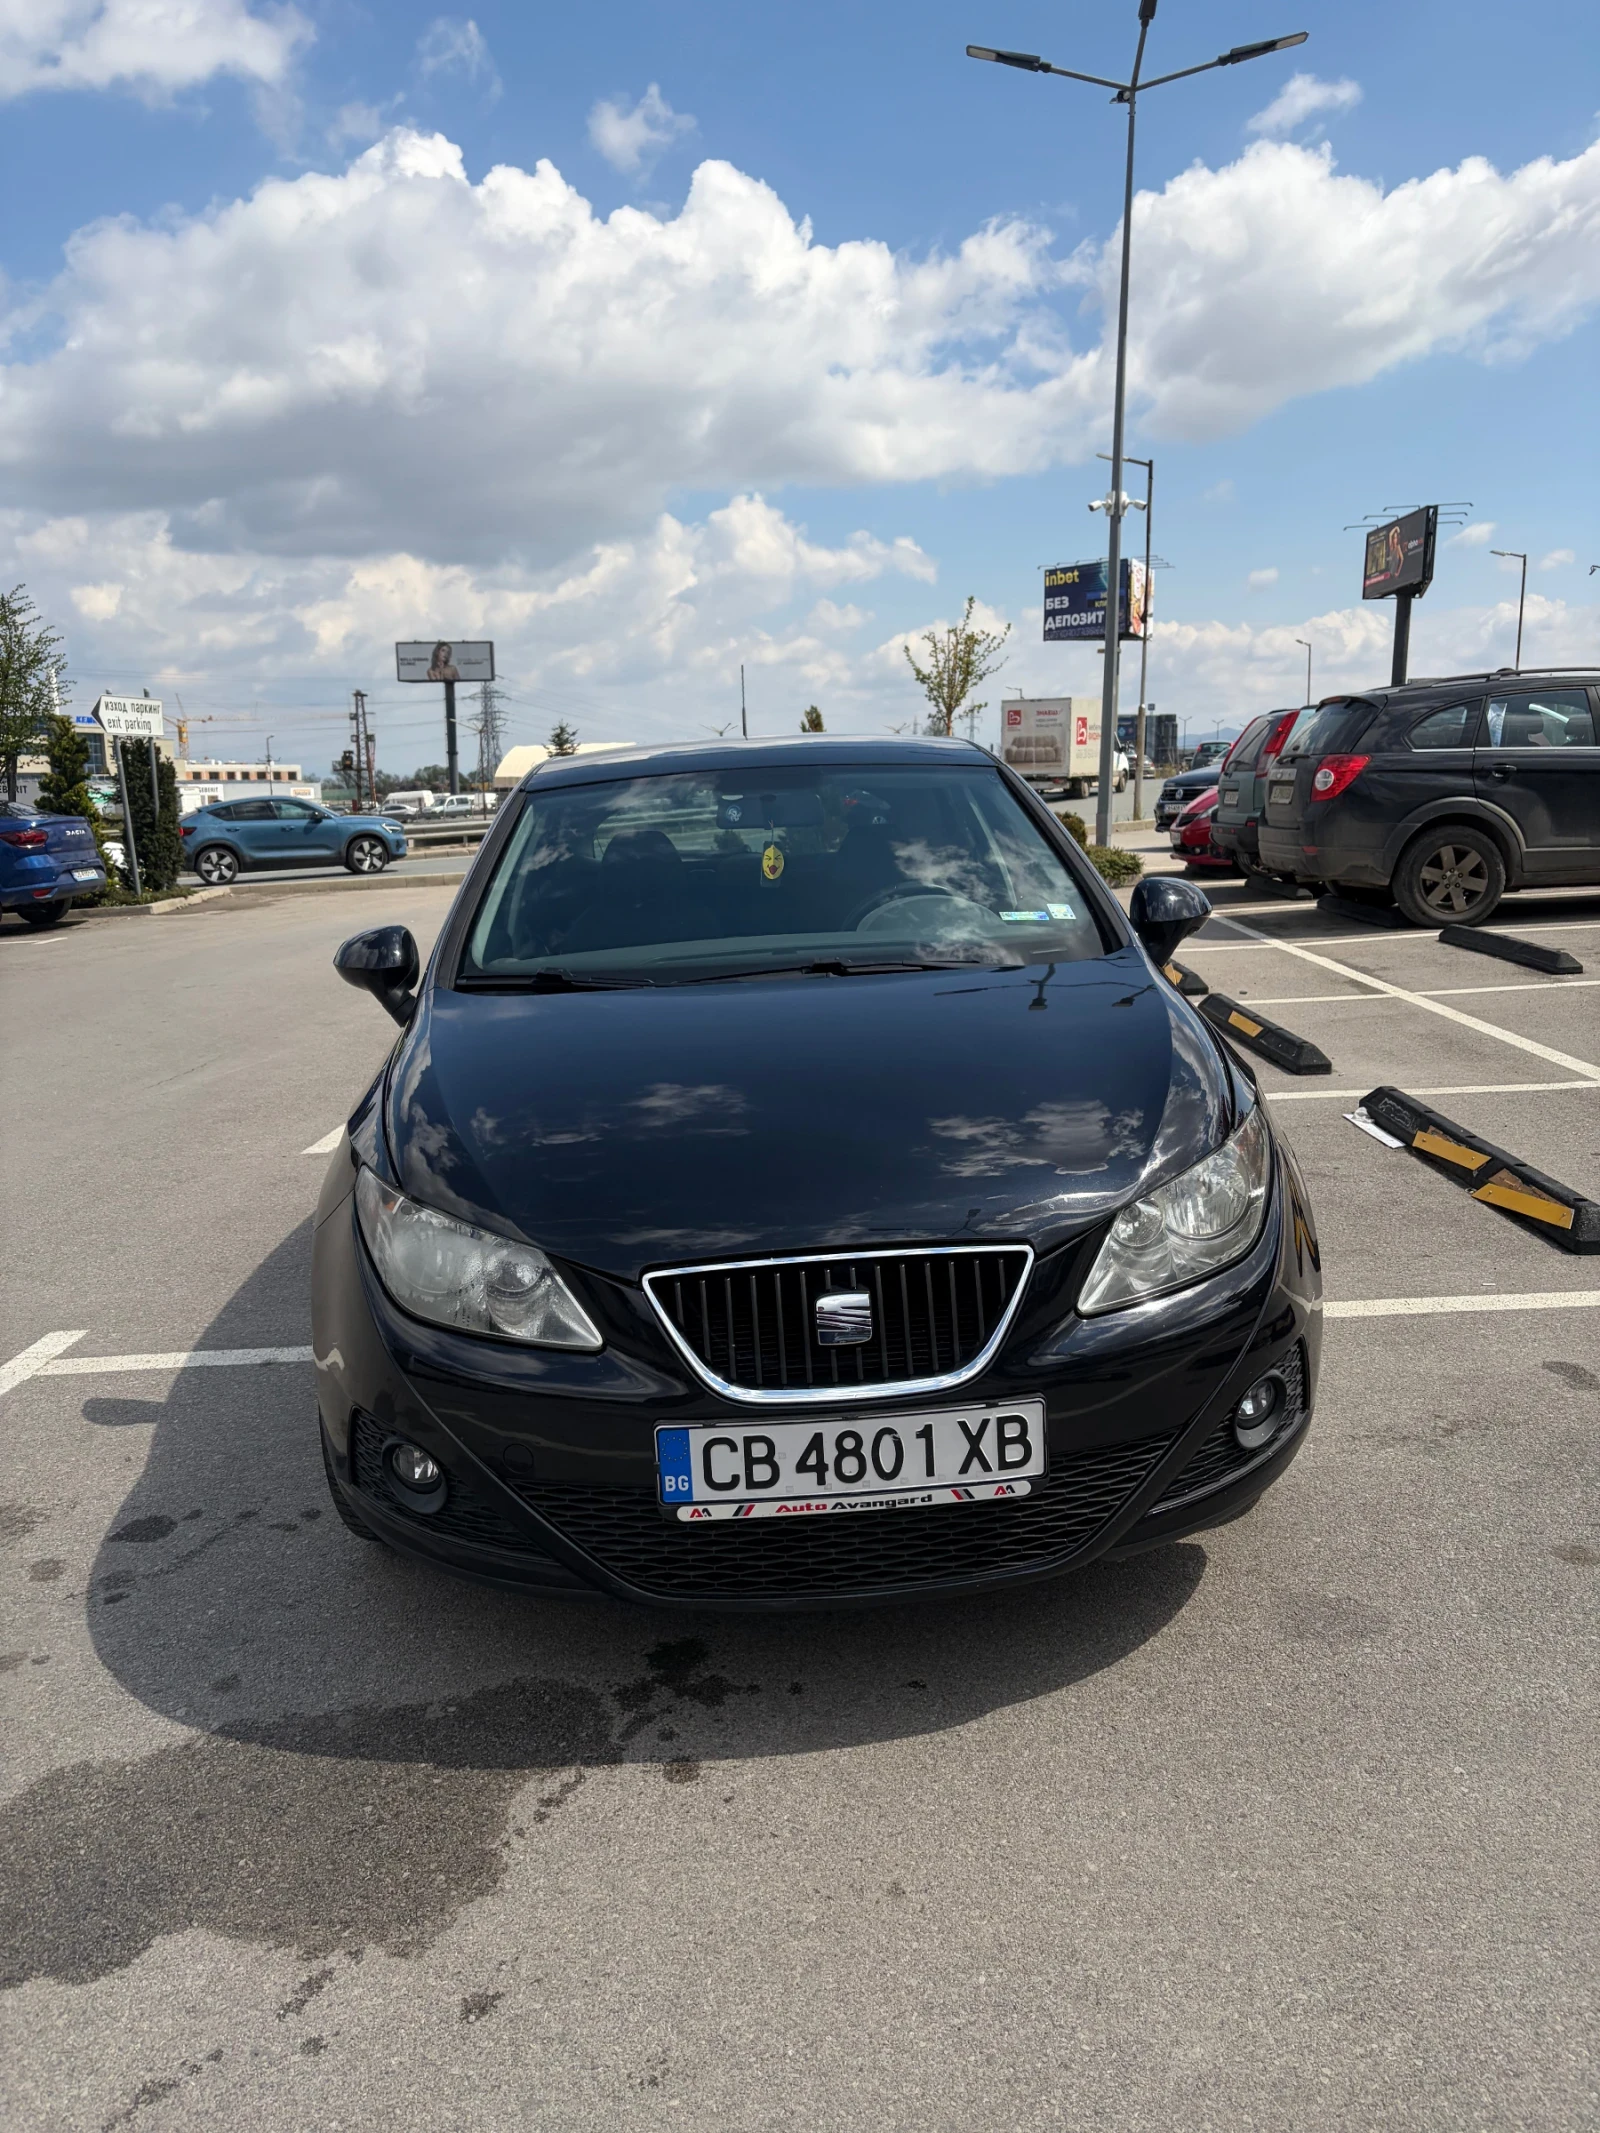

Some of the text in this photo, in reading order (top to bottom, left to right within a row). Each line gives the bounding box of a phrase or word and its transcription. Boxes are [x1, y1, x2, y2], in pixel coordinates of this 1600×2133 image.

[1045, 569, 1079, 587] inbet
[1045, 595, 1069, 610] БЕЗ
[1044, 611, 1104, 631] ДЕПОЗИТ
[104, 701, 160, 716] изход паркинг
[107, 716, 152, 734] exit parking
[795, 1423, 936, 1487] 4801
[664, 1474, 690, 1492] BG
[775, 1502, 828, 1513] Auto
[830, 1494, 933, 1511] Avangard
